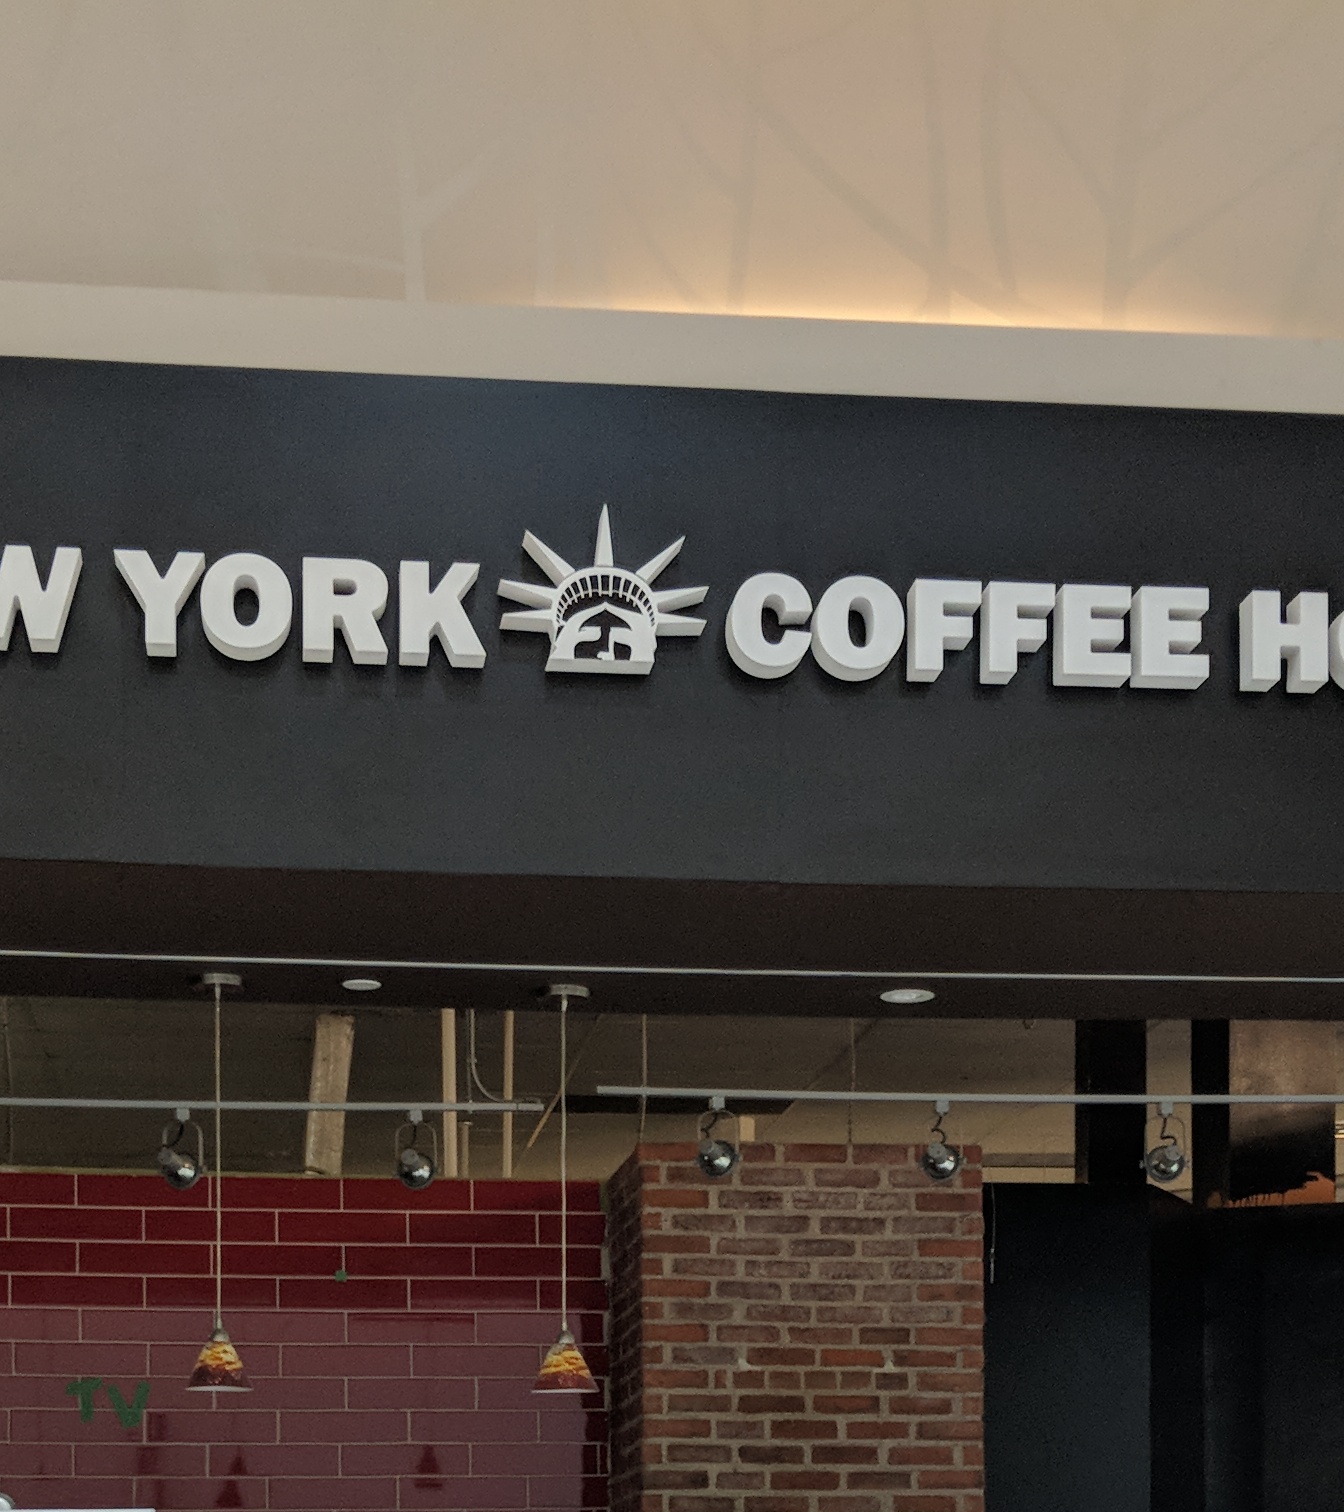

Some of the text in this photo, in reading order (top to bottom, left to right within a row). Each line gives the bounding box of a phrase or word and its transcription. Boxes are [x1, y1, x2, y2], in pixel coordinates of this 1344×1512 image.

[114, 549, 487, 669] YORK
[724, 571, 1210, 691] COFFEE
[65, 1377, 152, 1430] TV
